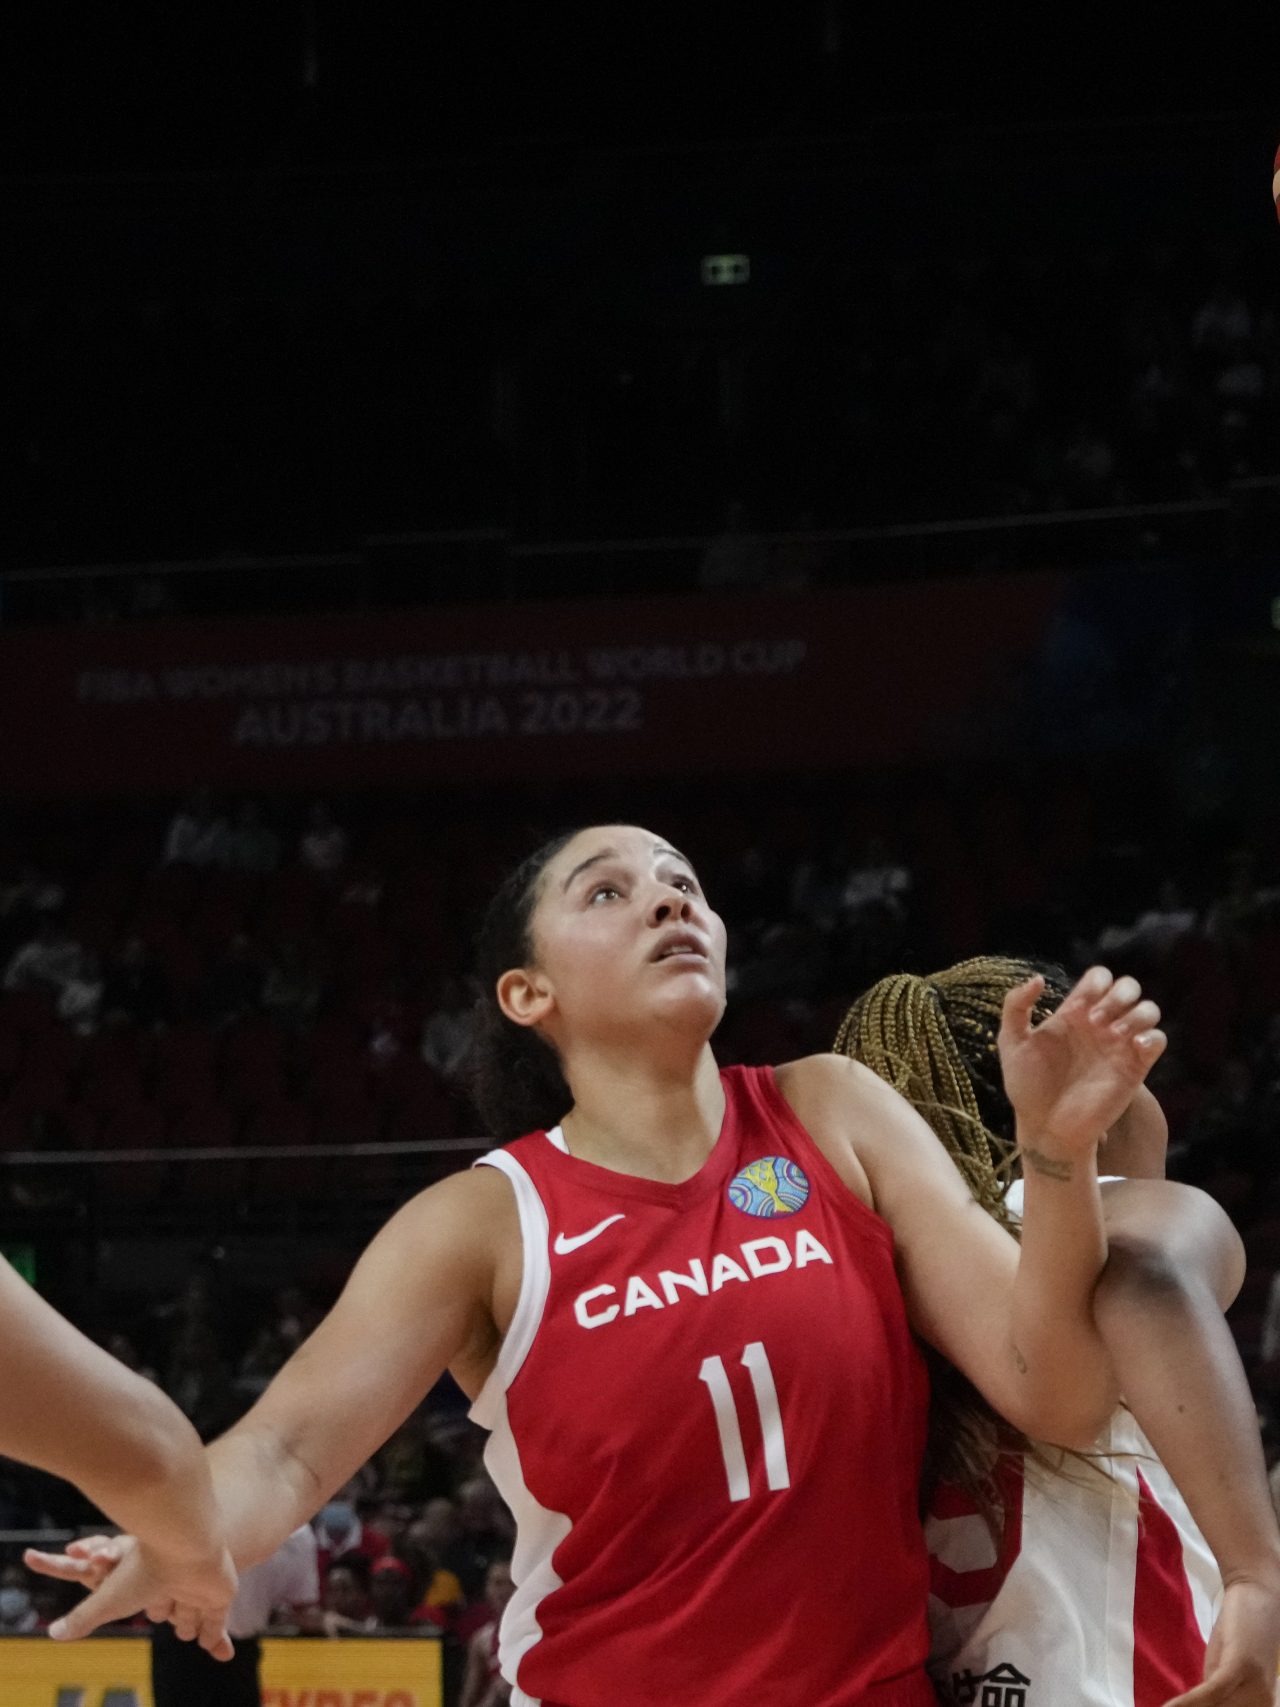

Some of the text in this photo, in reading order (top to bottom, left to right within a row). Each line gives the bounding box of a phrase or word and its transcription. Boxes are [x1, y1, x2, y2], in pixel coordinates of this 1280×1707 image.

[344, 653, 579, 691] BASKETBALL
[586, 642, 724, 682] WORLD
[731, 638, 808, 675] CUP
[232, 687, 645, 747] AUSTRALIA 2022
[573, 1228, 834, 1330] CANADA
[698, 1341, 791, 1503] 11
